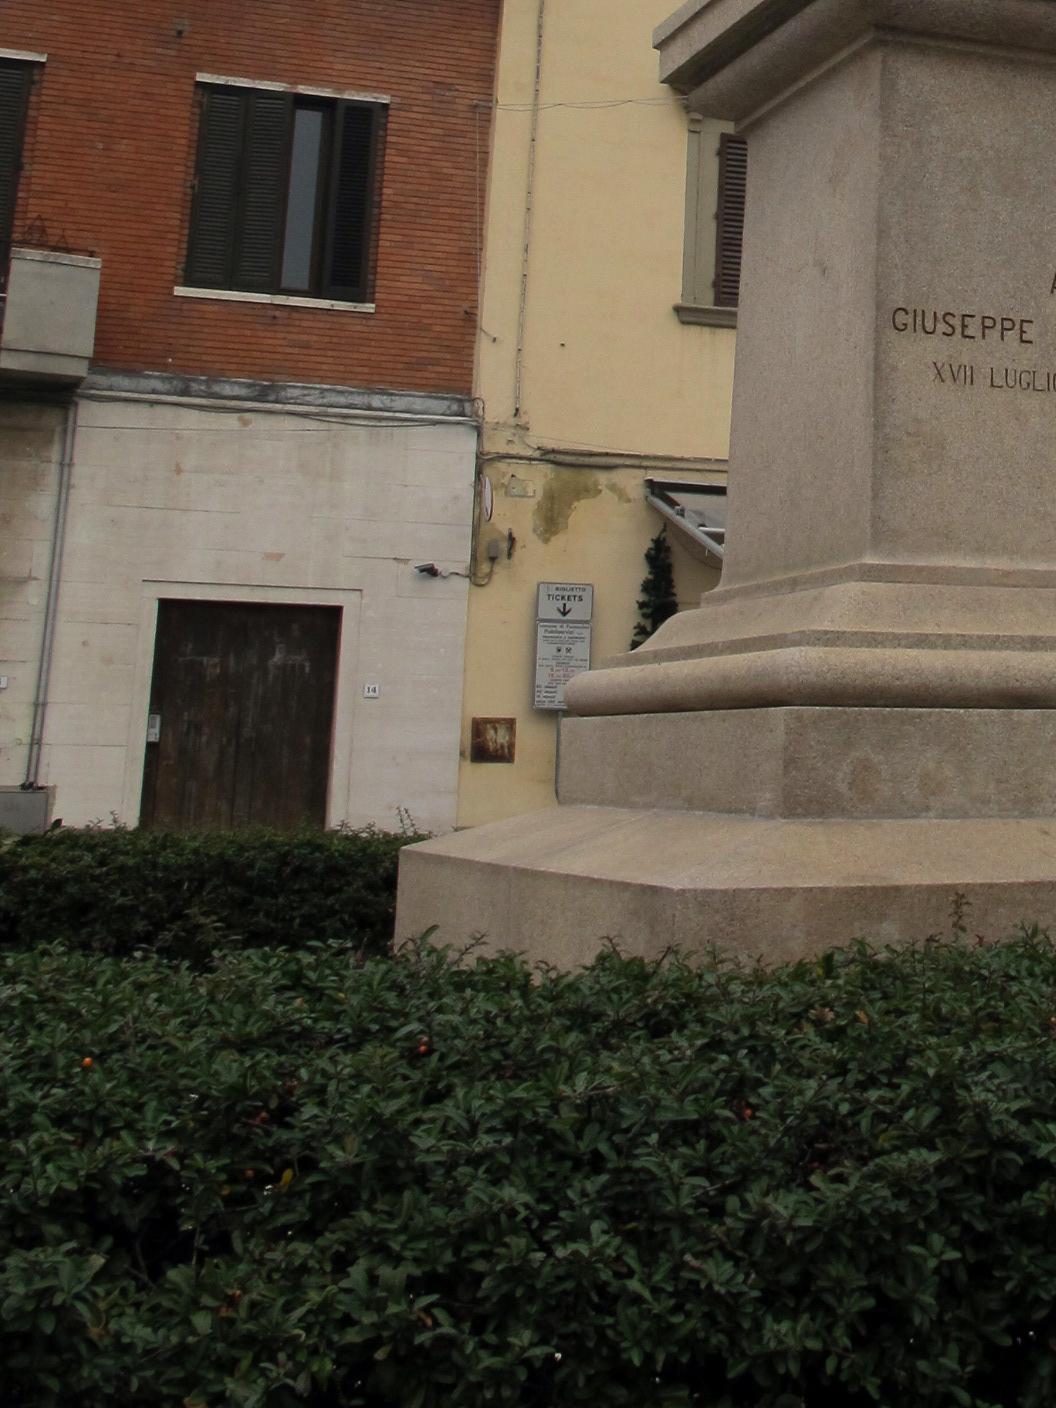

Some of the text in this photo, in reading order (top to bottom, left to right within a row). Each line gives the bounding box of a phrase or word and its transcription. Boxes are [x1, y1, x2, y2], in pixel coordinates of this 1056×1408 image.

[892, 307, 1034, 344] GIUSEPPE
[932, 361, 974, 386] XVII
[547, 593, 583, 602] TICKETS
